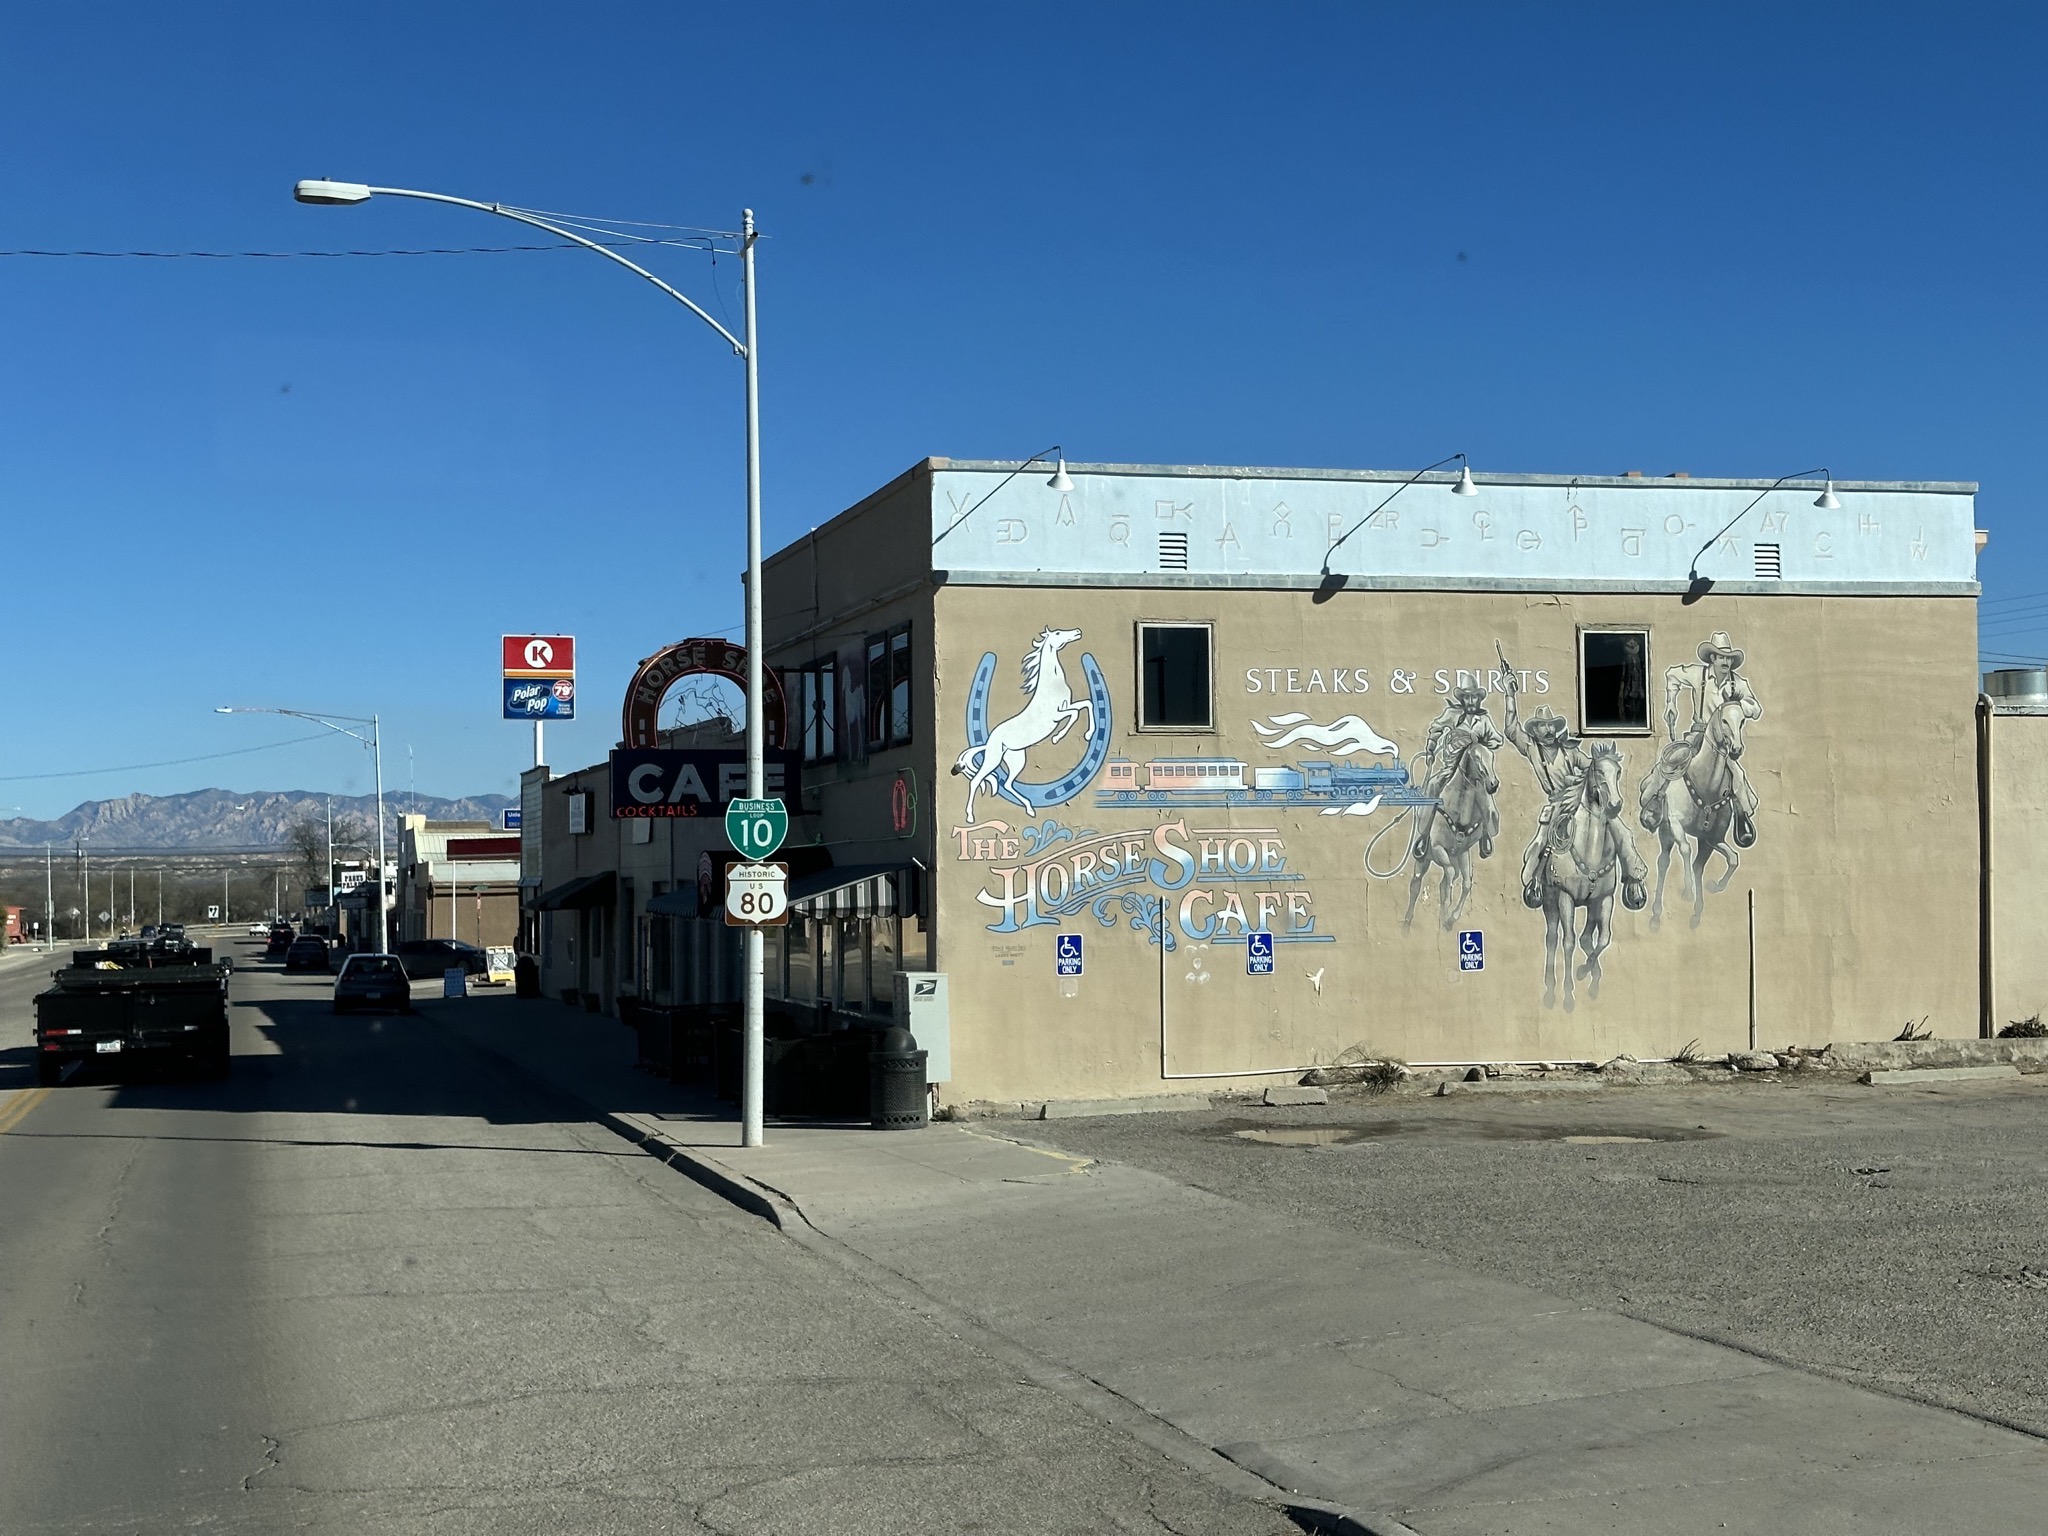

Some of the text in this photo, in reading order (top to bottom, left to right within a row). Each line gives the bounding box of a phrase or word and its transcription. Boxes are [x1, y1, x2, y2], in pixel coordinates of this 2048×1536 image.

[635, 647, 779, 704] HORSE SHE
[1246, 668, 1370, 694] STEAKS
[1390, 669, 1417, 694] &
[513, 685, 541, 702] Polar
[527, 697, 548, 712] Pop
[628, 763, 786, 803] CAFE
[616, 804, 698, 817] COCKTAILS
[739, 802, 776, 811] BUSINESS
[740, 819, 773, 848] 10
[951, 819, 1021, 861] THE
[738, 871, 776, 879] HISTORIC
[976, 818, 1287, 934] HORSE SHOE
[740, 892, 774, 915] 80
[1179, 889, 1317, 941] CAFE
[1058, 958, 1081, 966] PARKING
[1249, 955, 1274, 965] PARKING
[1461, 953, 1482, 961] PARKING
[1062, 966, 1077, 974] ONLY
[1253, 964, 1269, 974] ONLY
[1465, 961, 1479, 969] ONLY
